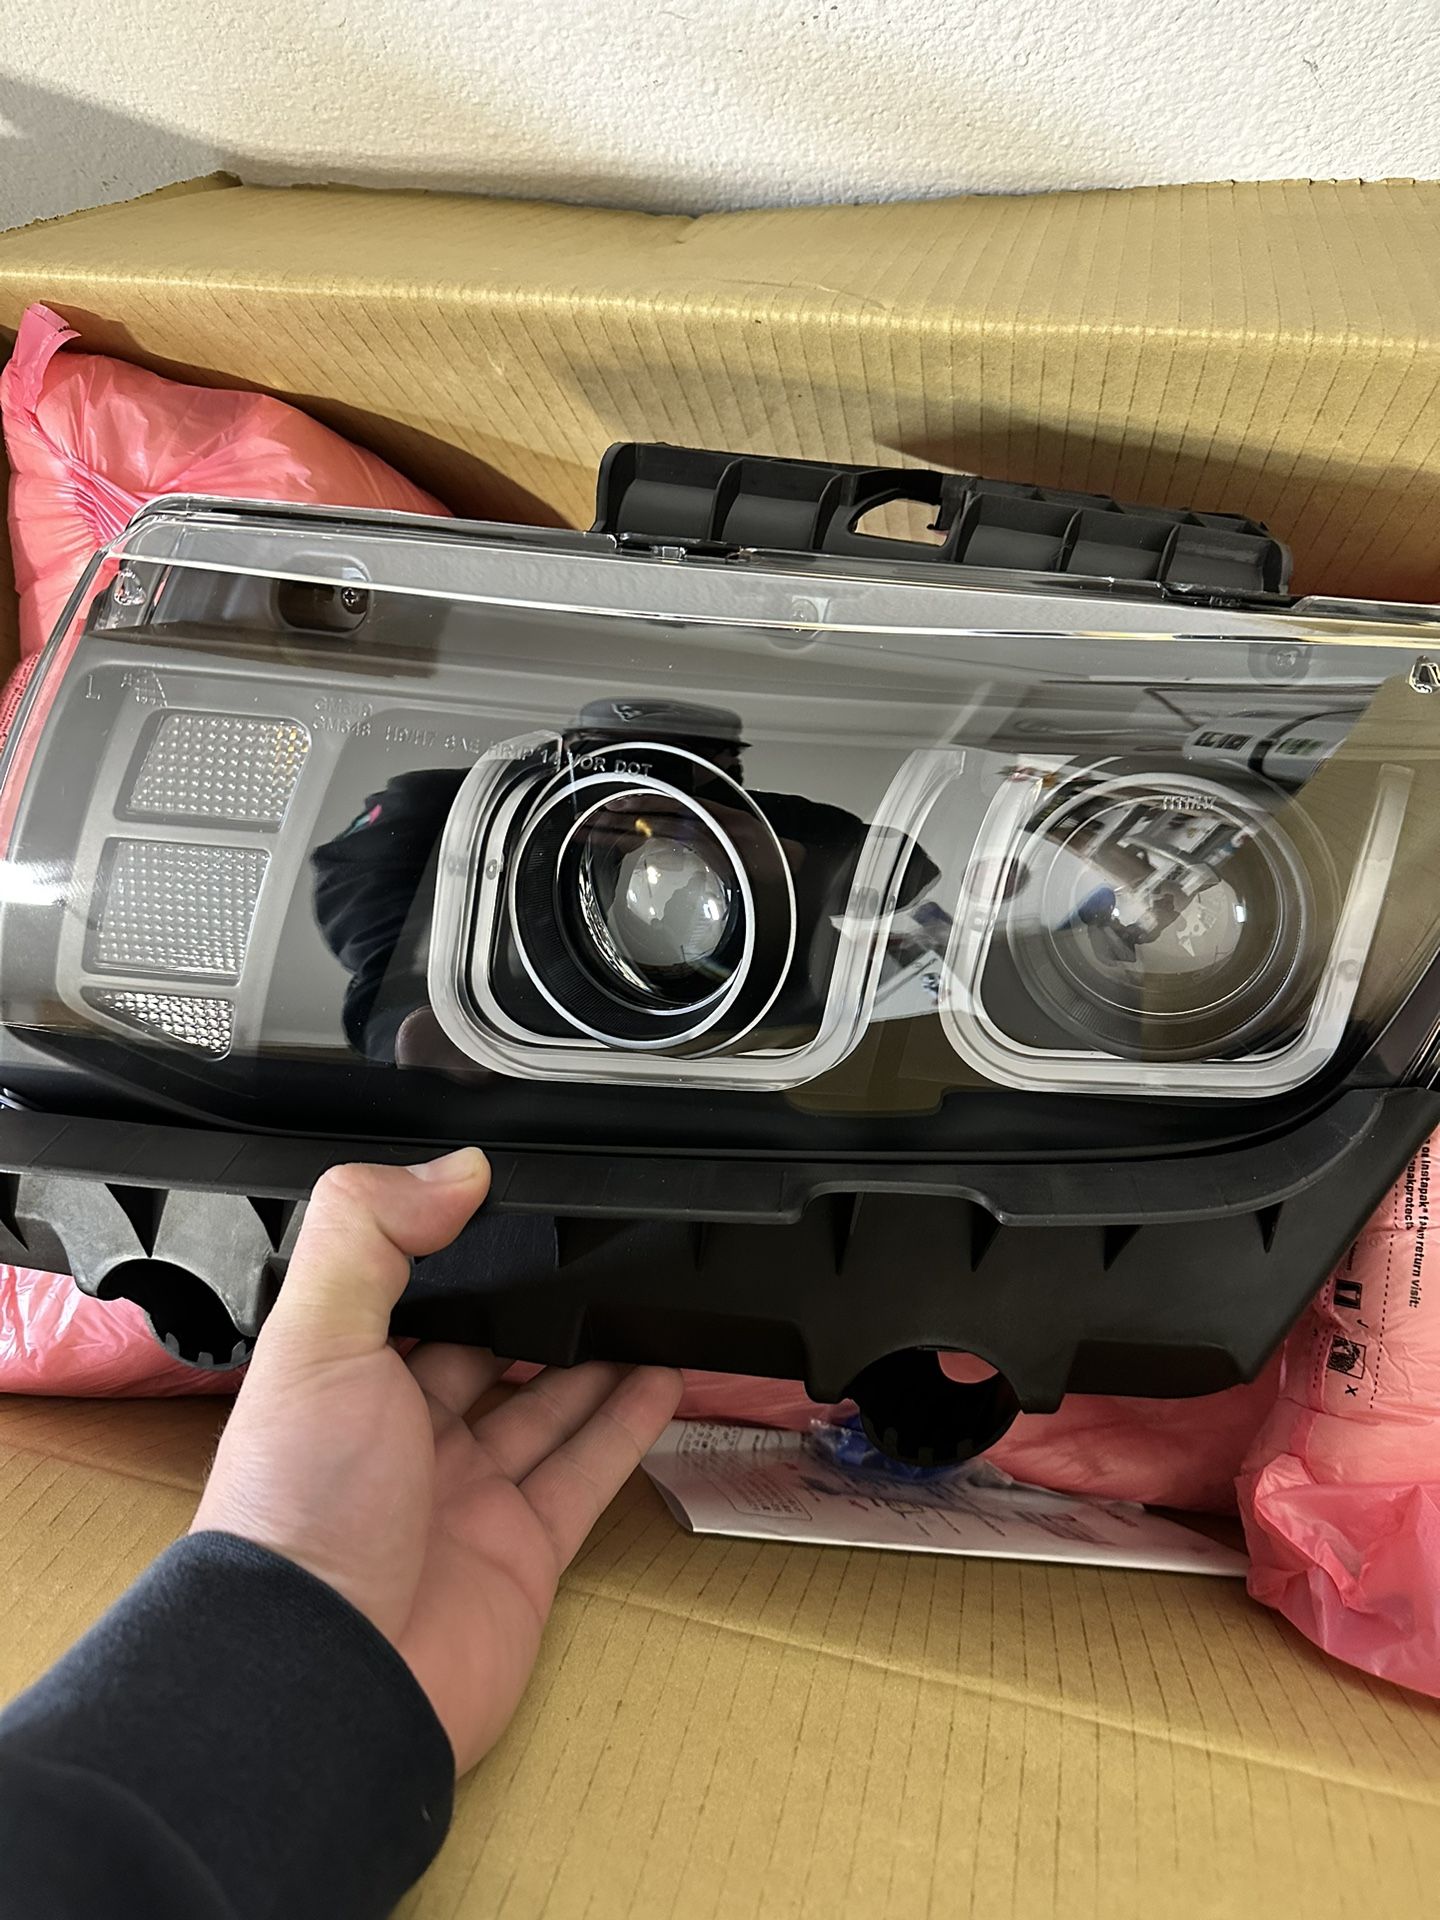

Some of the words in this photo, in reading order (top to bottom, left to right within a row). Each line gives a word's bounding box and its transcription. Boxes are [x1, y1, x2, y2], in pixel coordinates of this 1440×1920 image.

[614, 760, 653, 777] DOT
[1412, 1241, 1425, 1278] return
[1408, 1279, 1422, 1309] visit:
